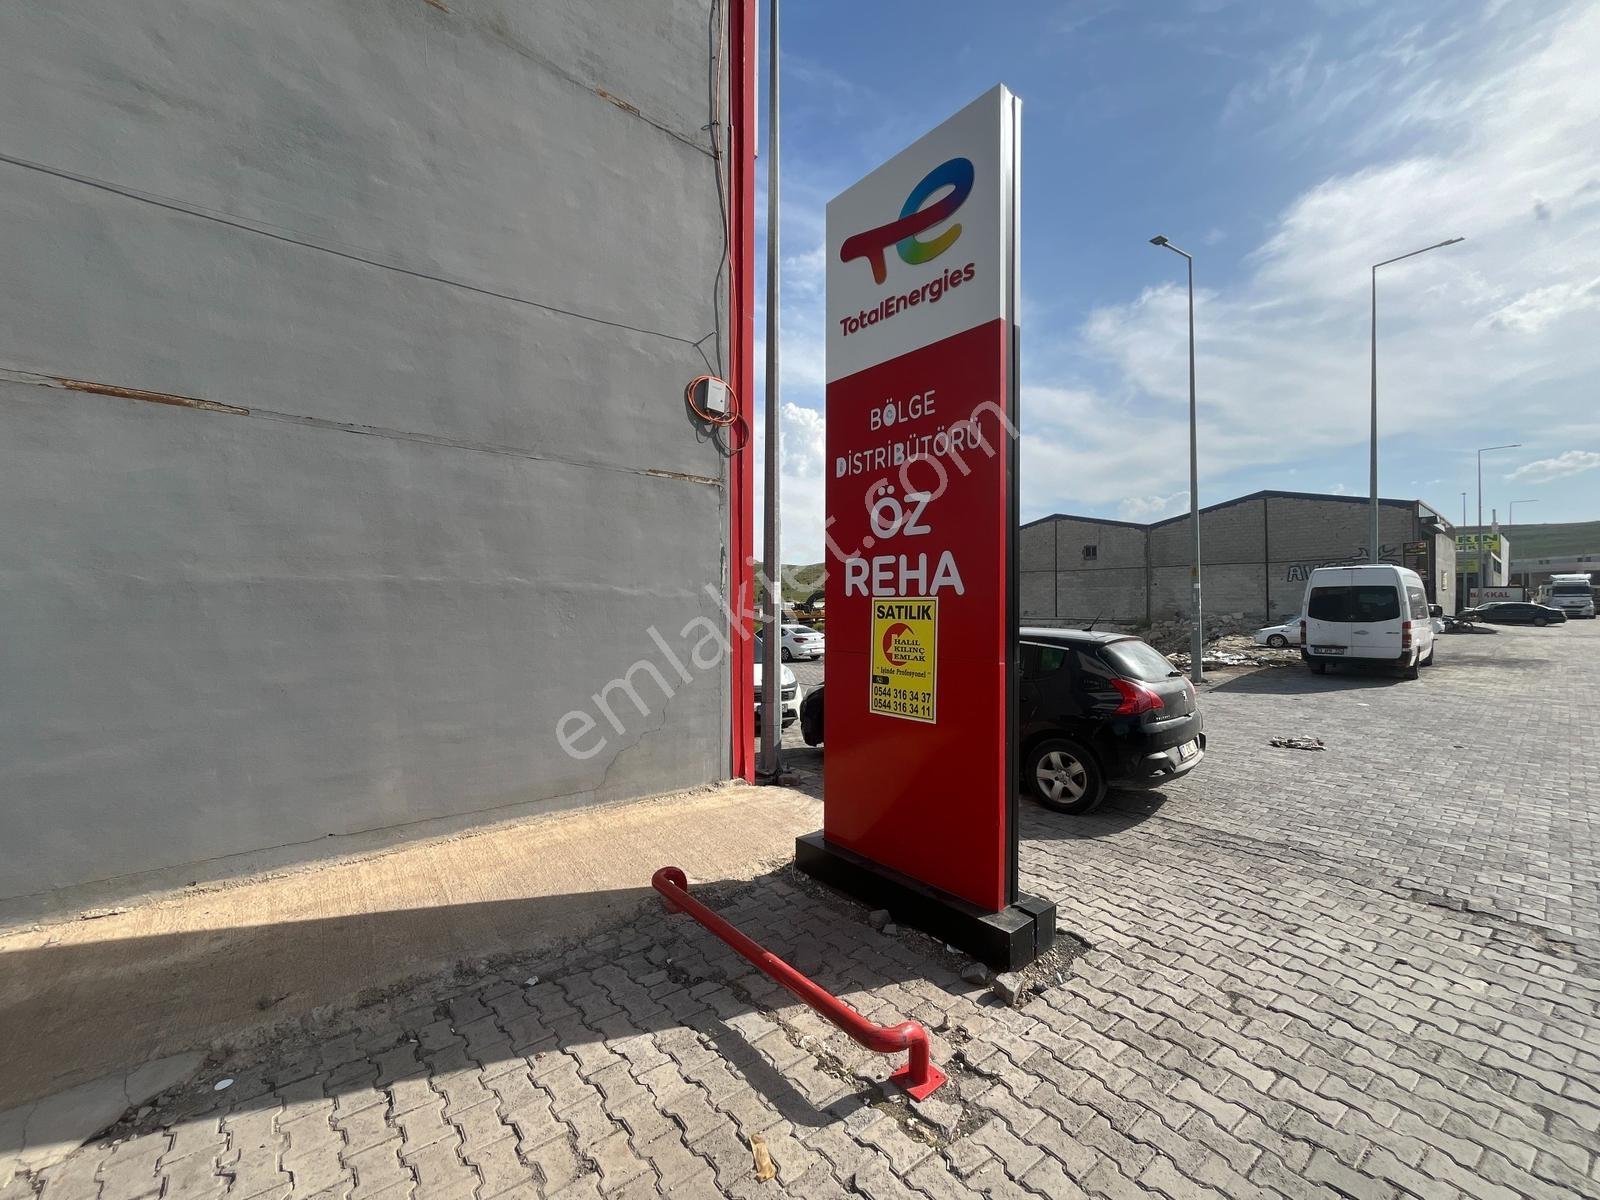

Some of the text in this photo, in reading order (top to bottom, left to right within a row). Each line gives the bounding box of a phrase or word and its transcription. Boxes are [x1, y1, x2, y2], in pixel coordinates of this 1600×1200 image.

[840, 262, 976, 336] TotalEnergies
[870, 389, 936, 431] BÖLGE
[835, 416, 982, 478] DİSTRİBÜTÖRÜ
[870, 485, 931, 539] ÖZ
[845, 550, 965, 597] REHA
[876, 604, 932, 620] SATILIK
[894, 654, 925, 662] EMLAK
[873, 686, 931, 703] 0544 316 34 37
[873, 698, 930, 716] 0544 316 34 11
